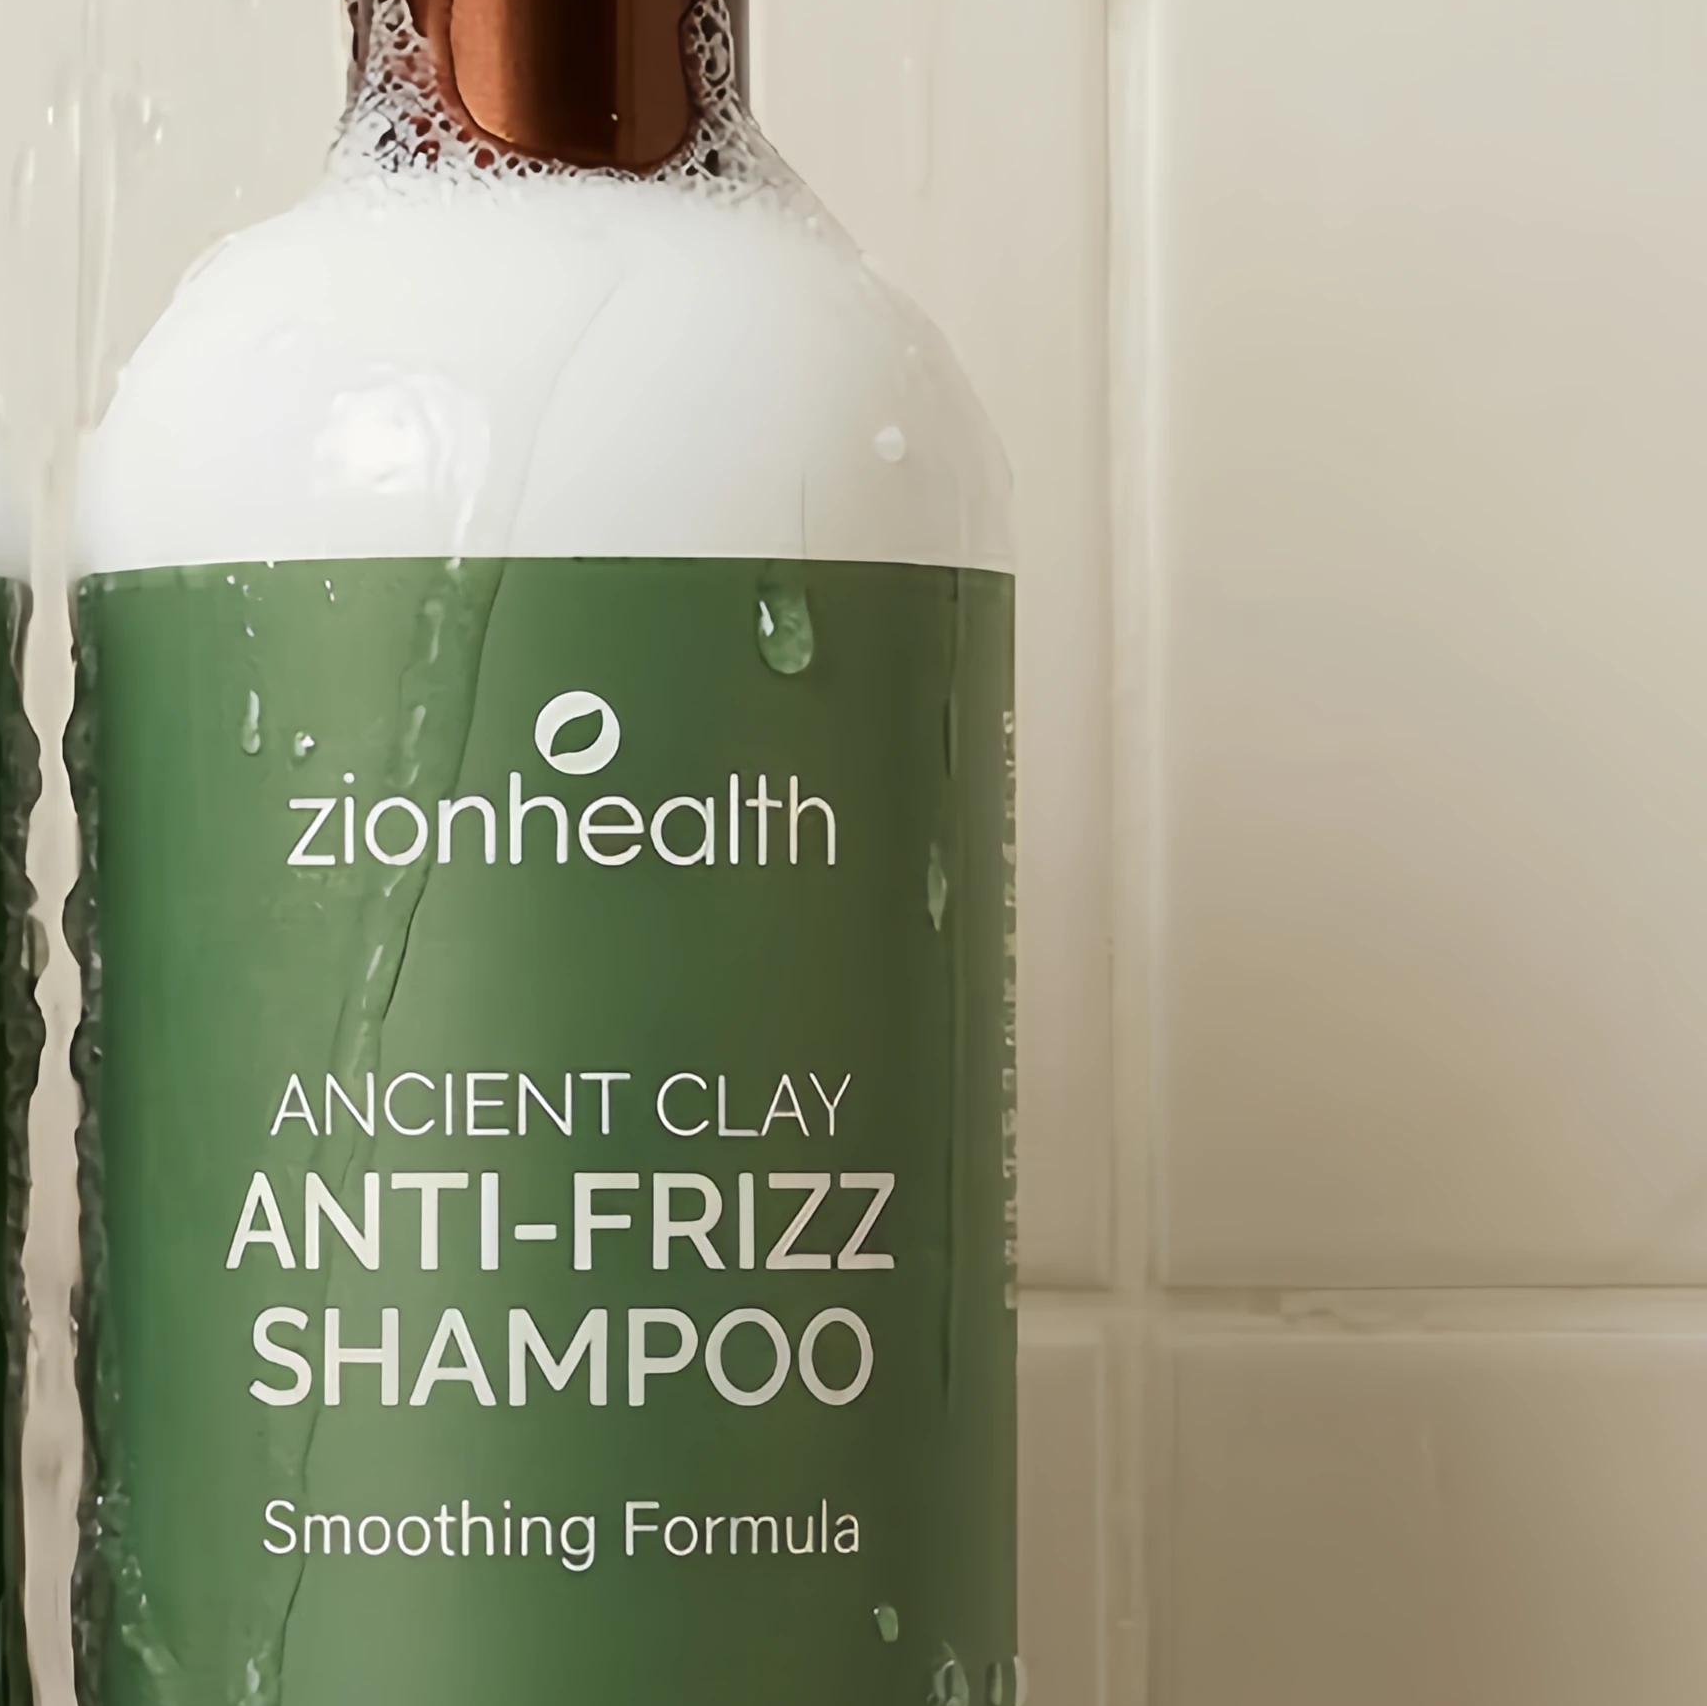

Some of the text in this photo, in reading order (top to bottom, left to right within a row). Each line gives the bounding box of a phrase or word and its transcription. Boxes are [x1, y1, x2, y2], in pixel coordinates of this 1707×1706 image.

[287, 771, 835, 865] zionhealth
[270, 1072, 850, 1136] ANCIENT CLAY
[226, 1172, 895, 1270] ANTI-FRIZZ
[250, 1307, 873, 1406] SHAMPOO
[264, 1499, 859, 1571] Smoothing Formula
